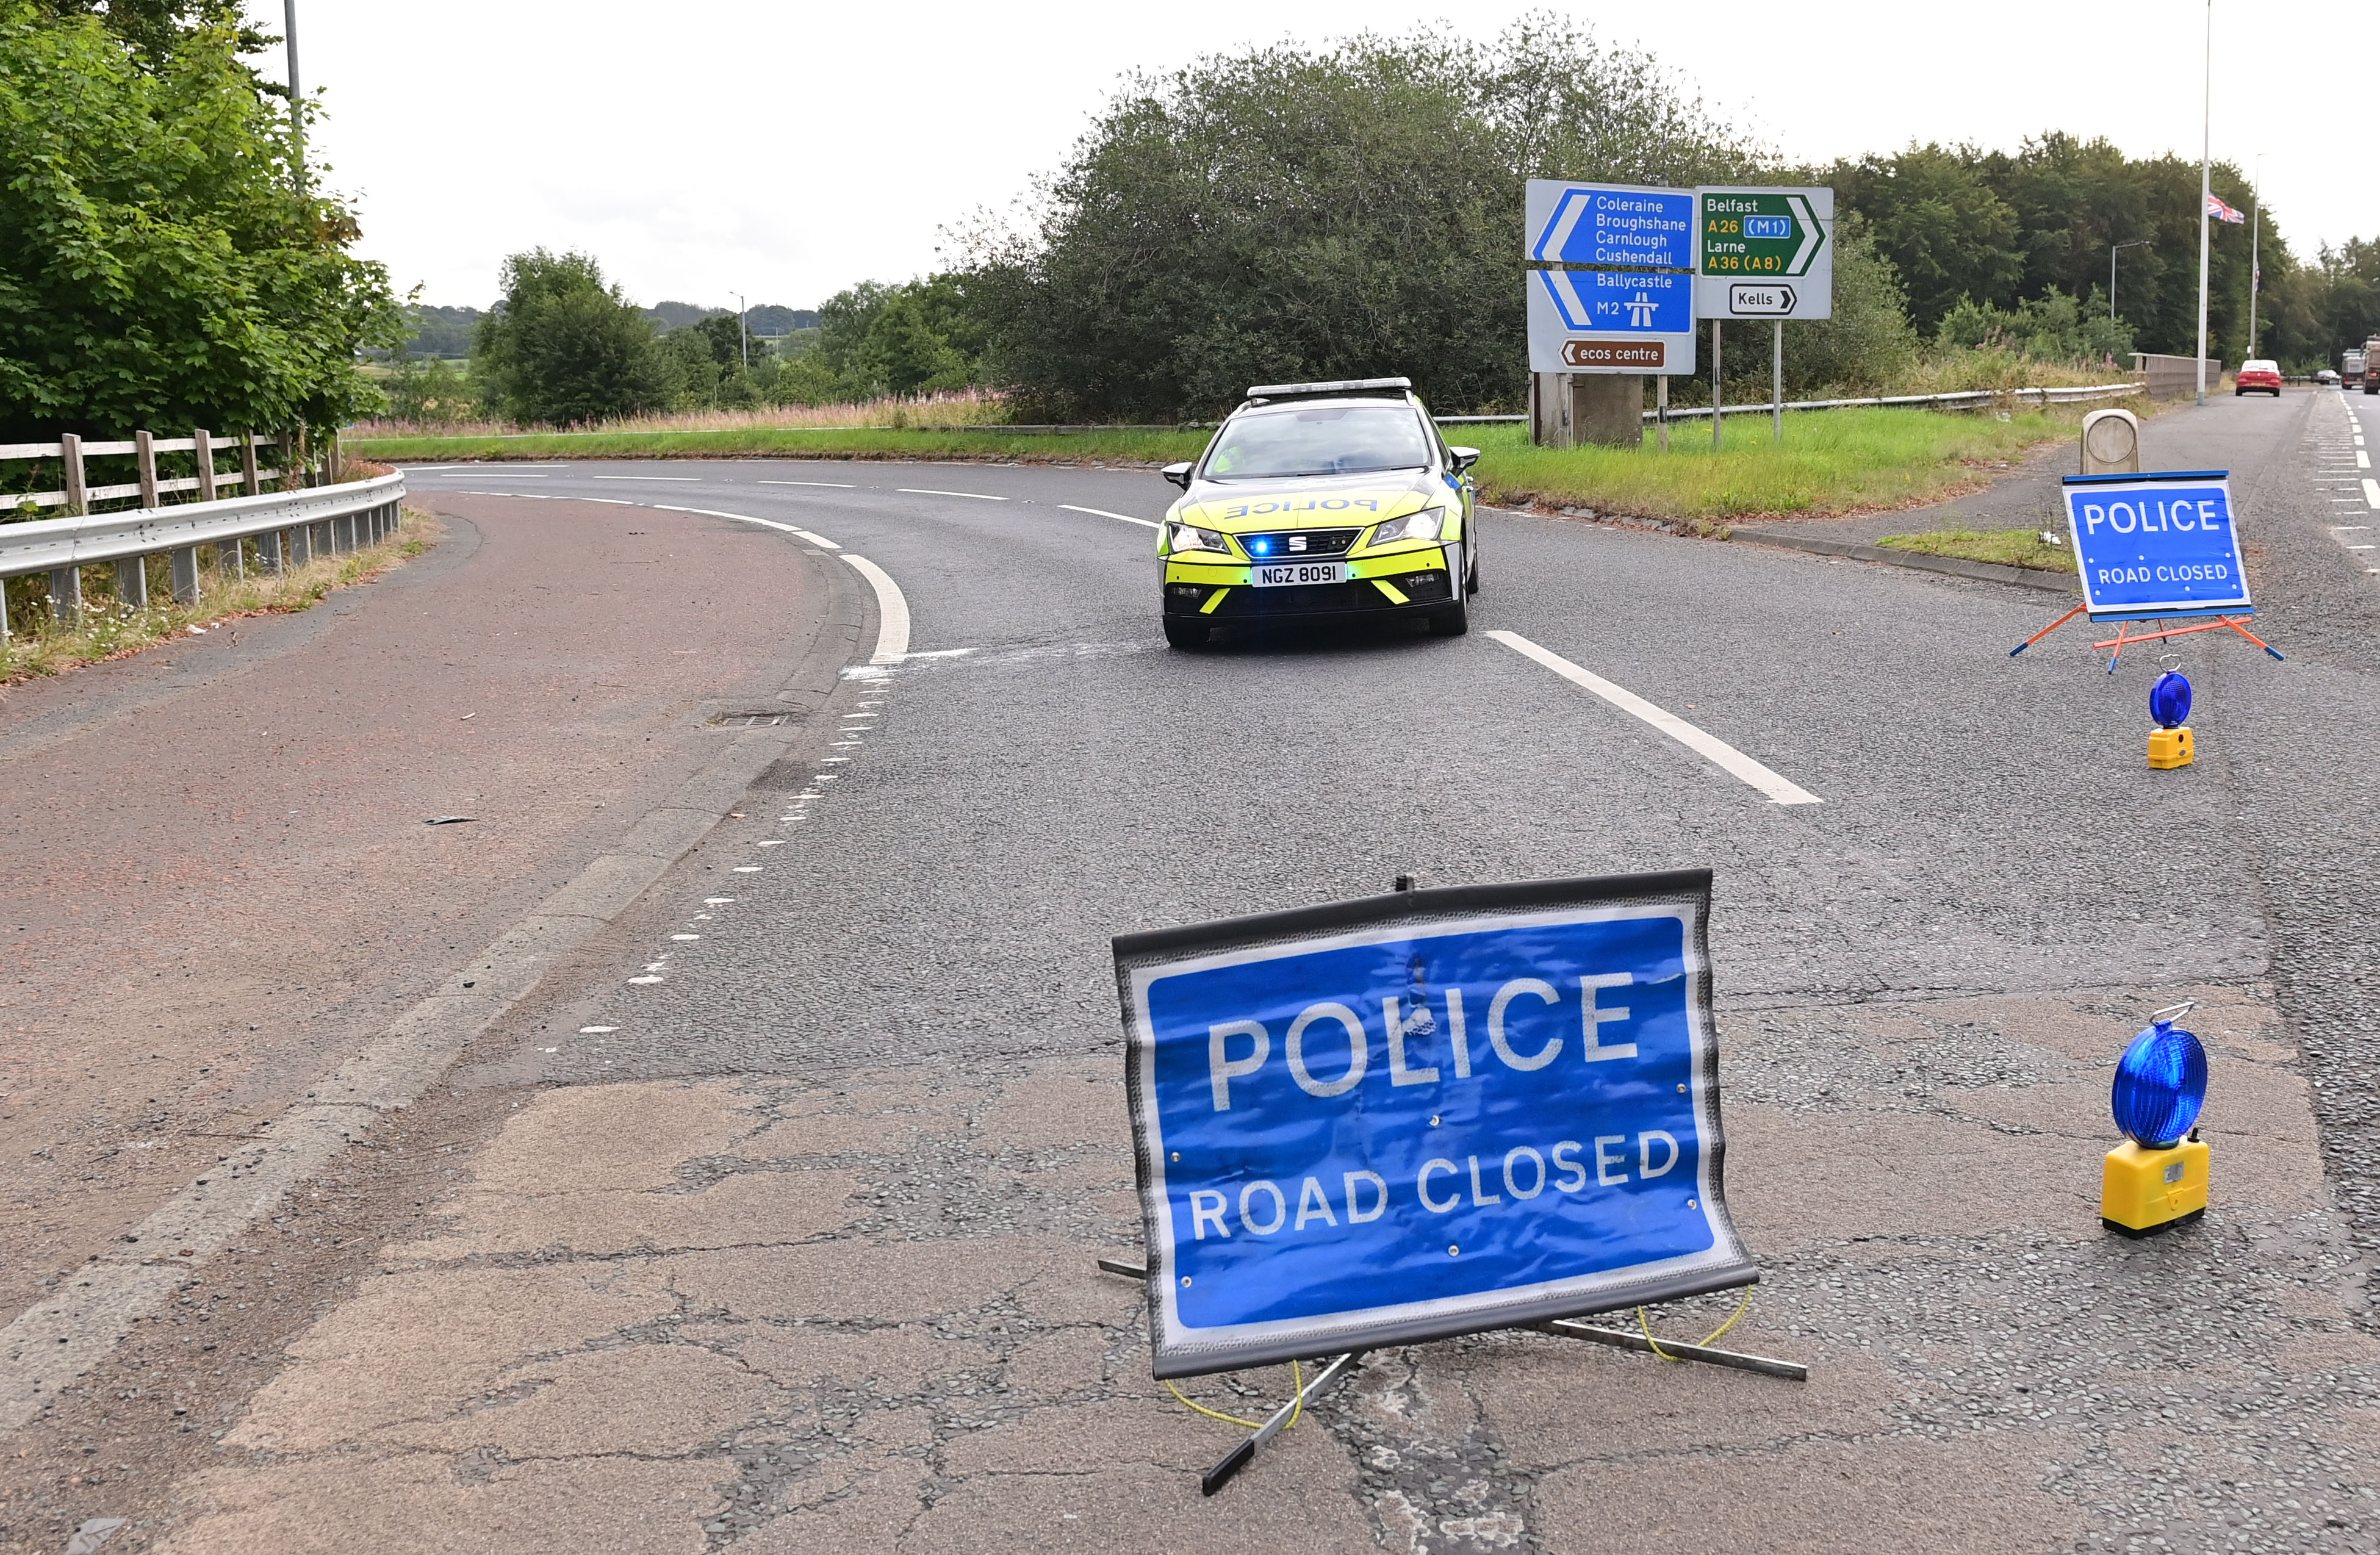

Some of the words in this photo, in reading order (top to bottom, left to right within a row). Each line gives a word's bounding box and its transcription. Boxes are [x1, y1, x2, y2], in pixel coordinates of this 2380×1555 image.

[1597, 196, 1663, 213] Coleraine
[1707, 198, 1758, 212] Belfast
[1597, 213, 1686, 231] Broughshane
[1708, 220, 1738, 233] A26
[1596, 231, 1667, 248] Carnlough
[1707, 240, 1745, 253] Larne
[1596, 248, 1672, 265] Cushendall
[1708, 257, 1739, 270] A36
[1597, 273, 1672, 289] Ballycastle
[1738, 293, 1772, 305] Kells
[1597, 302, 1619, 315] M2
[1580, 350, 1611, 360] ecos
[1616, 348, 1659, 361] centre
[2084, 500, 2220, 534] POLICE
[1262, 567, 1294, 583] NGZ
[1299, 566, 1336, 582] 8091
[2099, 567, 2150, 584] ROAD
[2156, 564, 2227, 581] CLOSED
[1208, 972, 1638, 1111] POLICE
[1190, 1171, 1389, 1240] ROAD
[1417, 1130, 1680, 1214] CLOSED
